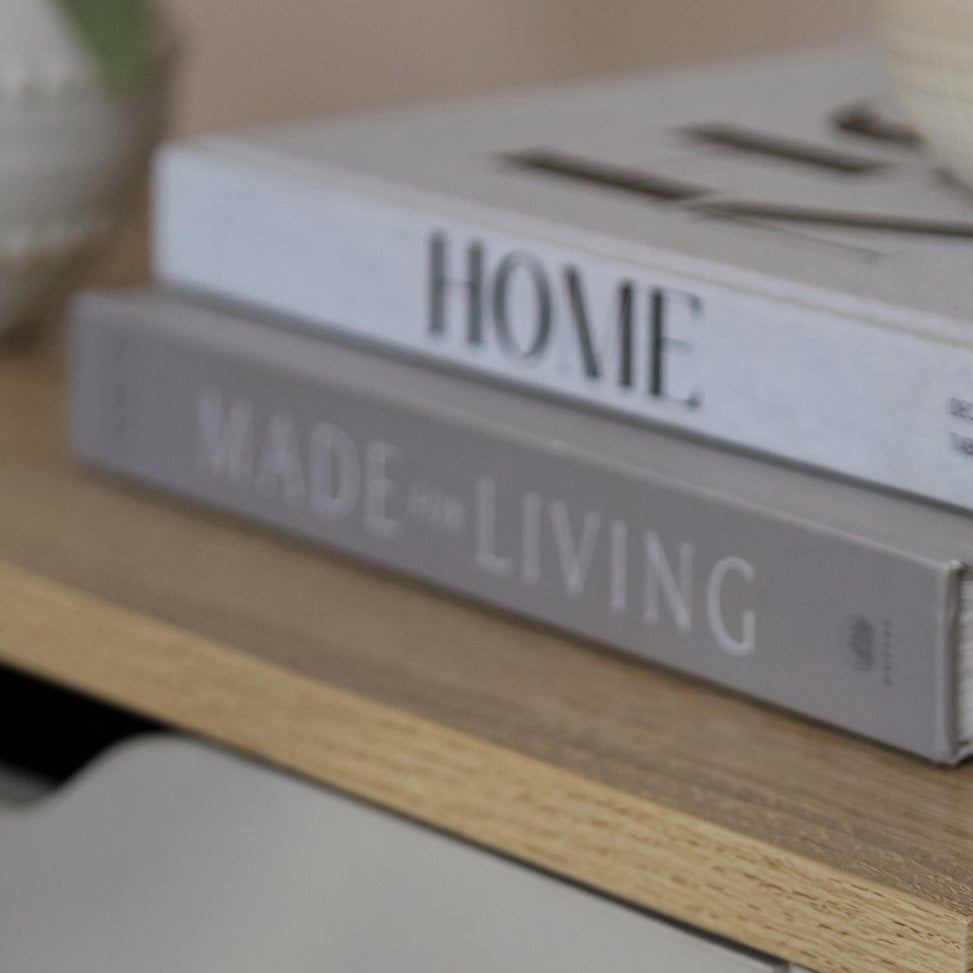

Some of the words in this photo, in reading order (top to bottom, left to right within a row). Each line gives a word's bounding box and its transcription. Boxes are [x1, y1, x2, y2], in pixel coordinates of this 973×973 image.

[426, 230, 705, 409] HOME
[197, 384, 404, 540] MADE
[475, 476, 757, 656] LIVING
